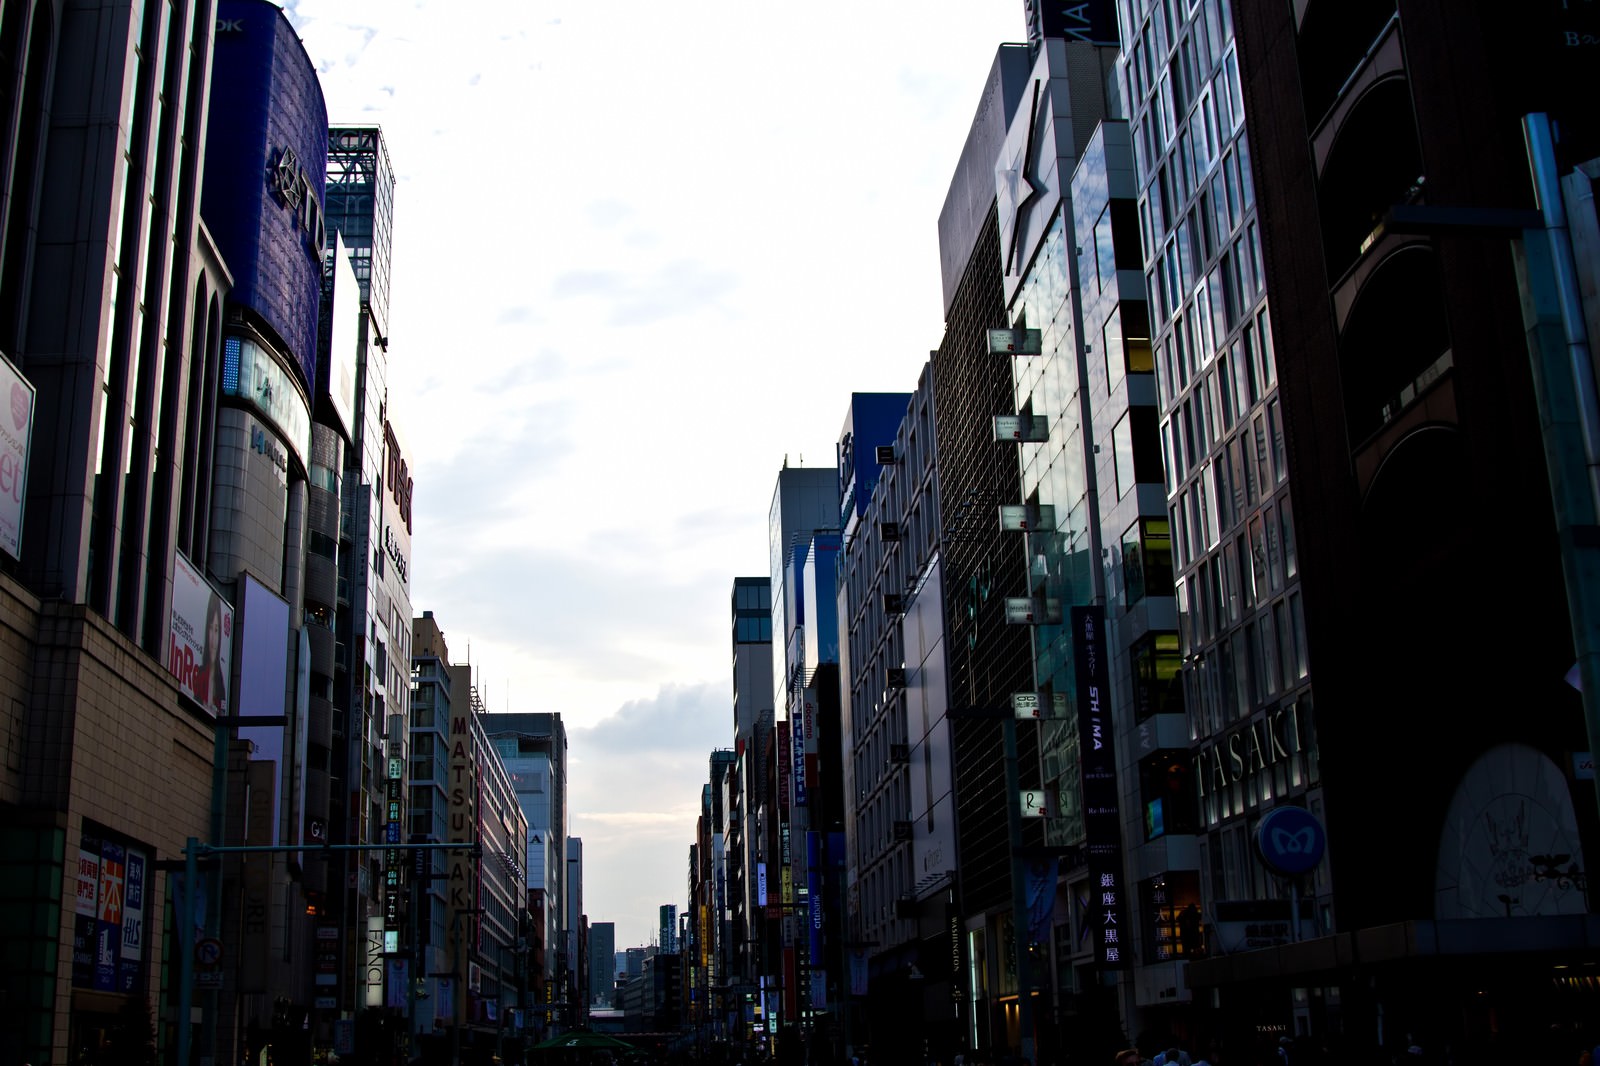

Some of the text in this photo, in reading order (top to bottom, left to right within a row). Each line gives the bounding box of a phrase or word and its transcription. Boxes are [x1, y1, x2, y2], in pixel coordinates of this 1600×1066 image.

[386, 420, 413, 535] THK
[806, 702, 814, 739] docomo
[1089, 685, 1103, 751] SHIMA
[1192, 702, 1303, 798] TASAKI
[78, 858, 98, 881] 貨両替
[814, 894, 823, 930] citibank
[1100, 873, 1119, 962] 銀座大黒屋
[1246, 923, 1288, 938] 銀座駅
[368, 930, 382, 992] FANCL
[952, 916, 960, 973] WASHINGTON
[1255, 1024, 1288, 1033] TASAKI
